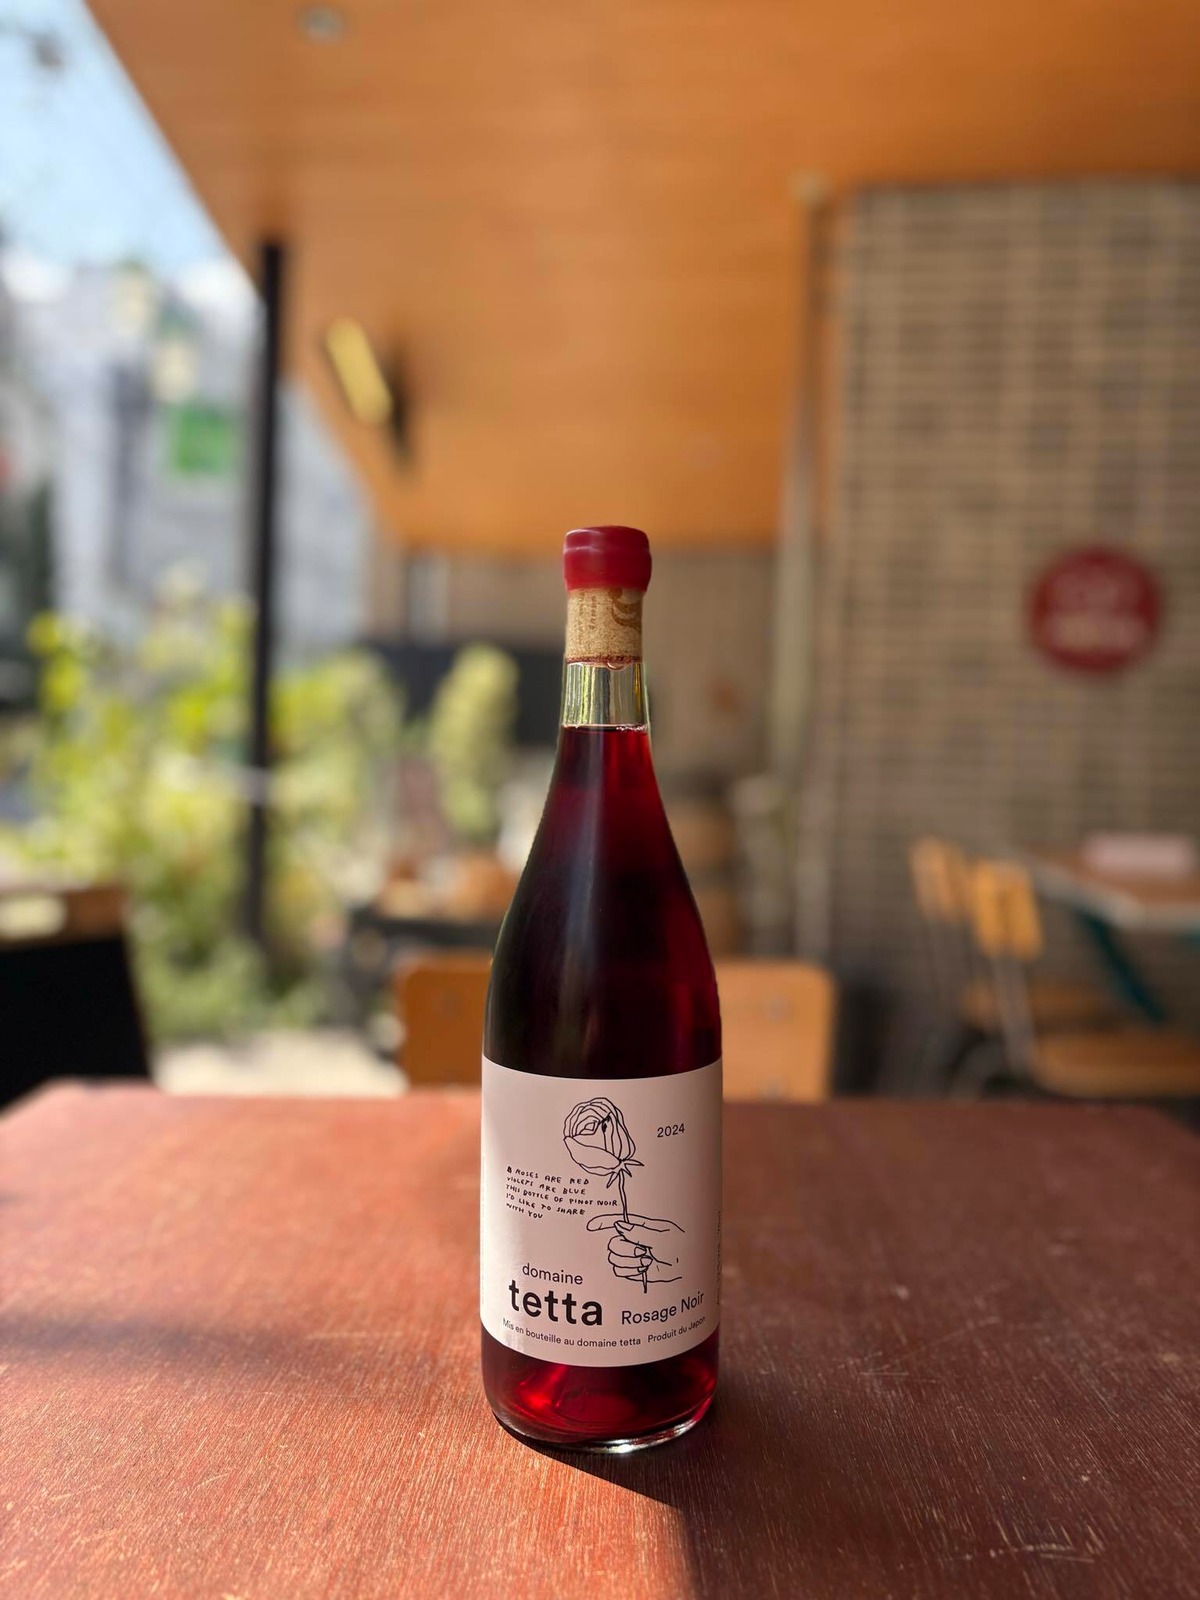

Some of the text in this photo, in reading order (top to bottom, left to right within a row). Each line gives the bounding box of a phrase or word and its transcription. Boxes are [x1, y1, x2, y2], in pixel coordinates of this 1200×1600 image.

[657, 1123, 685, 1138] 2024
[539, 1184, 556, 1193] ARE
[563, 1187, 586, 1195] BLUE
[544, 1175, 562, 1184] ARE
[506, 1203, 543, 1219] WITH YOU
[518, 1198, 535, 1208] LIKE
[556, 1207, 586, 1215] SHARE
[522, 1262, 583, 1285] domaine
[509, 1279, 602, 1326] tetta
[621, 1291, 704, 1325] Rosage Noir
[503, 1318, 641, 1347] Mis en bouteille au domaine tetta
[648, 1316, 706, 1343] Produit du Japon
